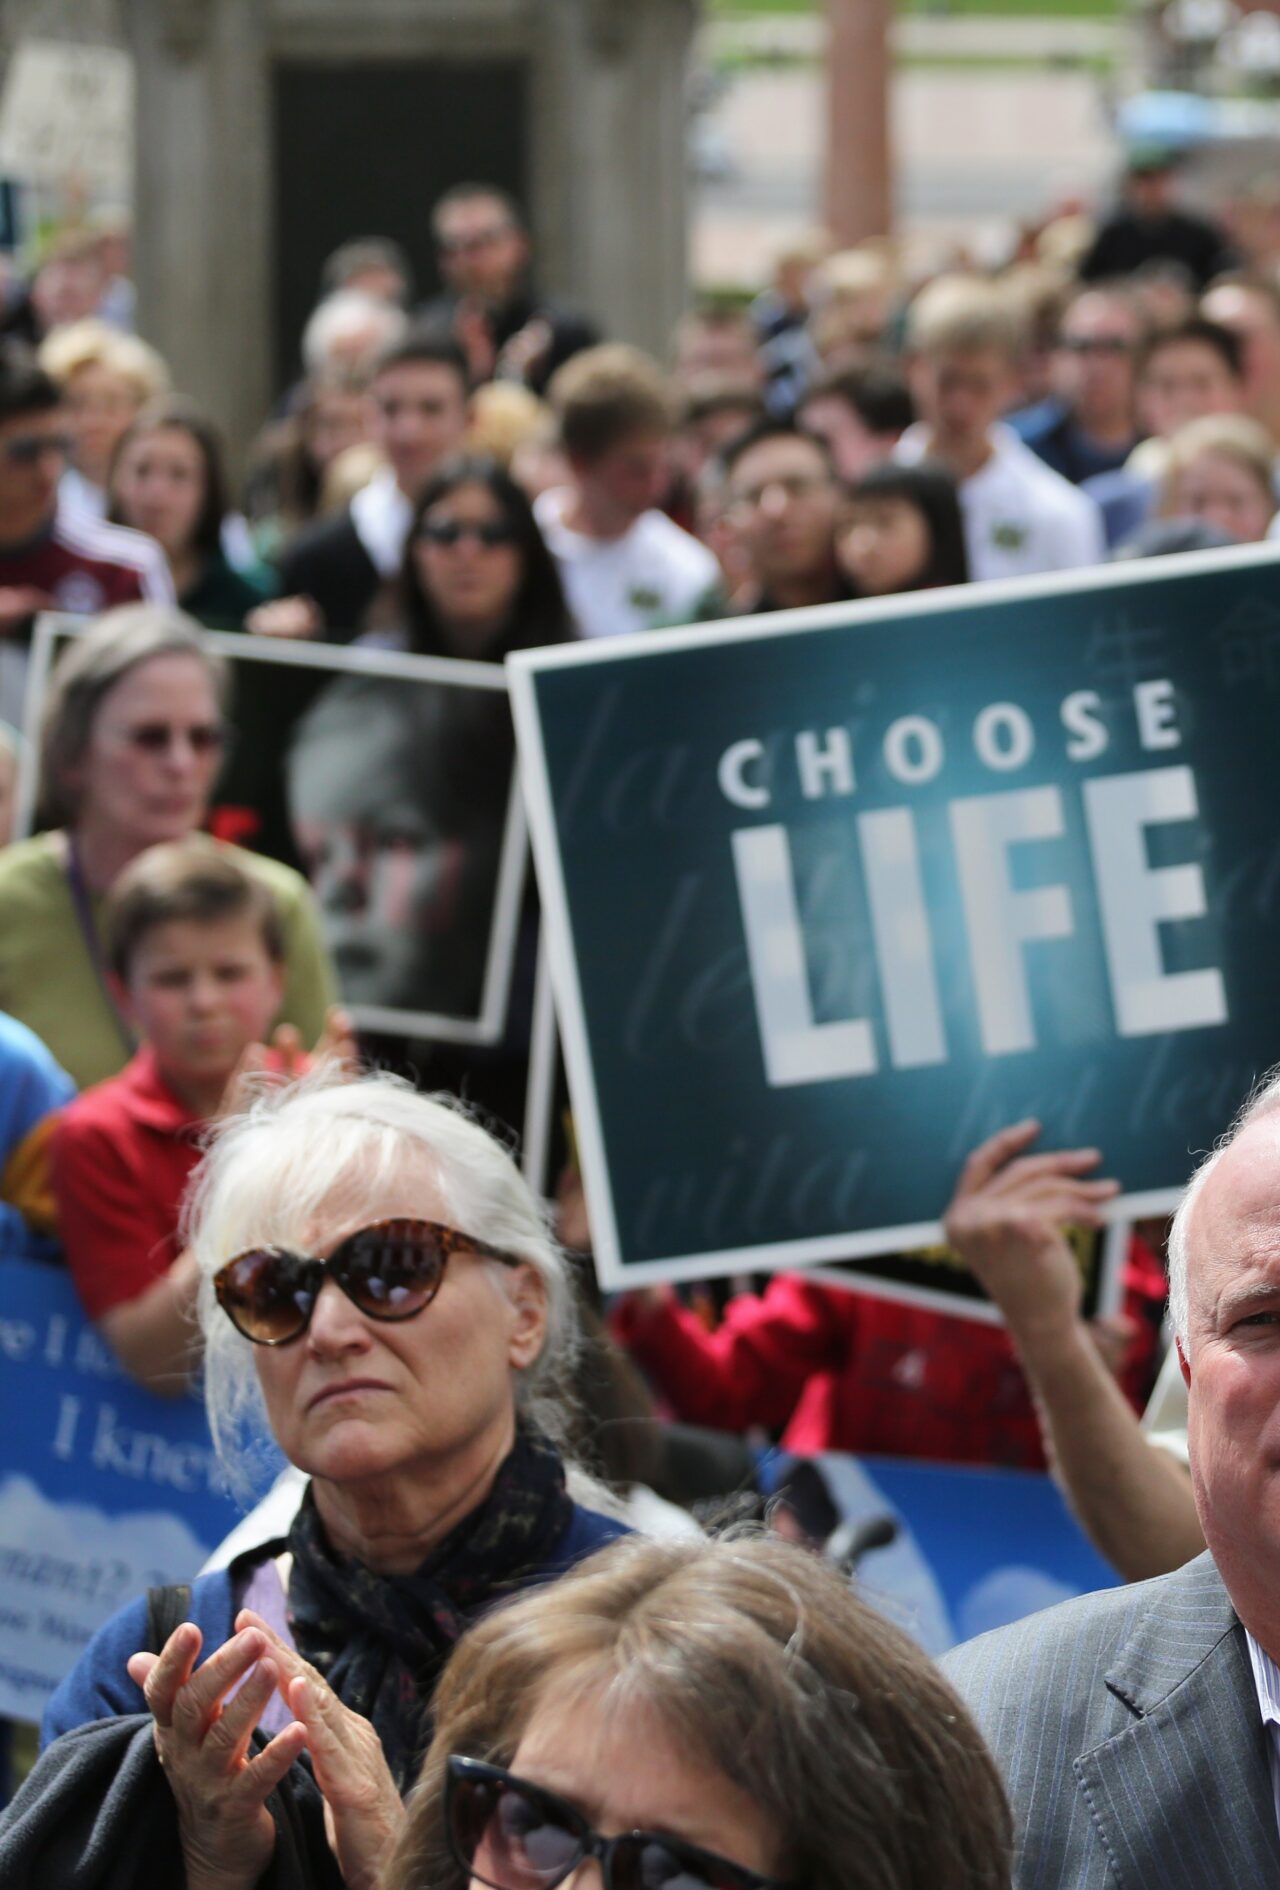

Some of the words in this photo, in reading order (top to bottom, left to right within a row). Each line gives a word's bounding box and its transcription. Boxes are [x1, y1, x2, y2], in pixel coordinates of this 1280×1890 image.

[719, 678, 1182, 807] CHOOSE
[731, 765, 1229, 1089] LIFE
[53, 1394, 82, 1460] I
